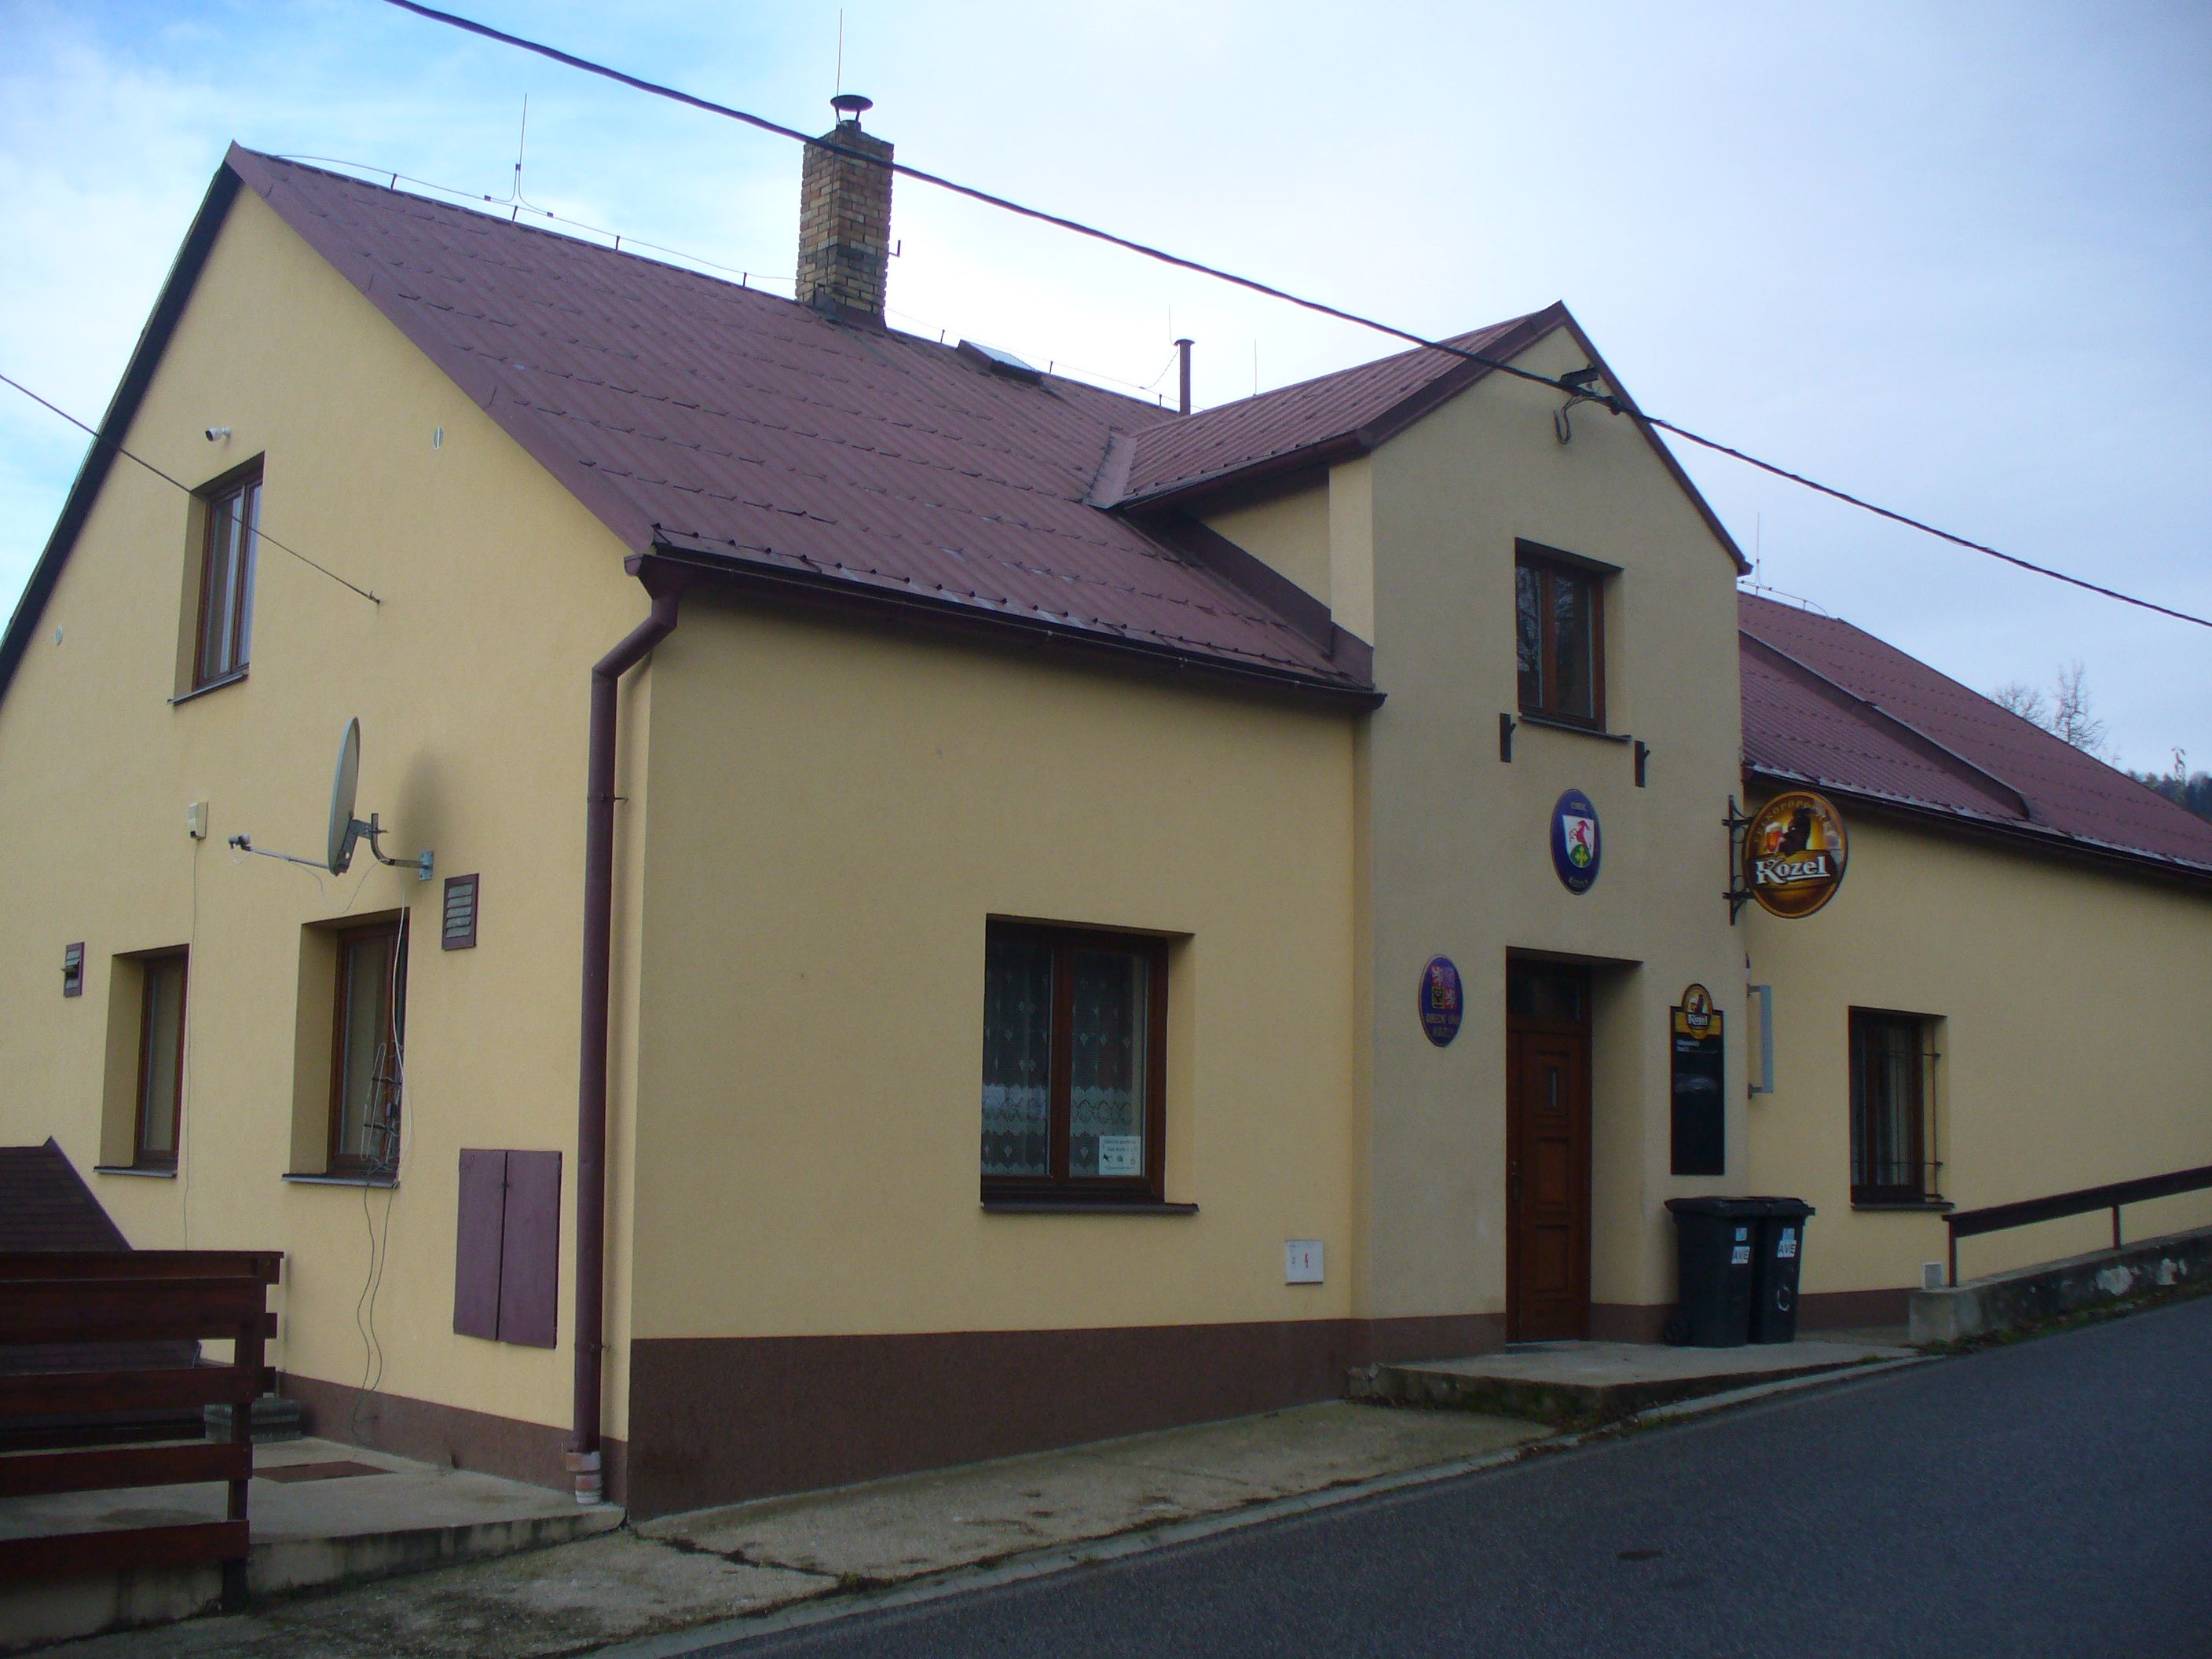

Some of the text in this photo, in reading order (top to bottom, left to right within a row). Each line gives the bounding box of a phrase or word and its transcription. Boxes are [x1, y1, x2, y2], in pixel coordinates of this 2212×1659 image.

[1755, 855, 1830, 884] Kozel
[1687, 1014, 1708, 1026] Kozel
[1778, 1243, 1796, 1254] AVE
[1732, 1250, 1749, 1261] AVE
